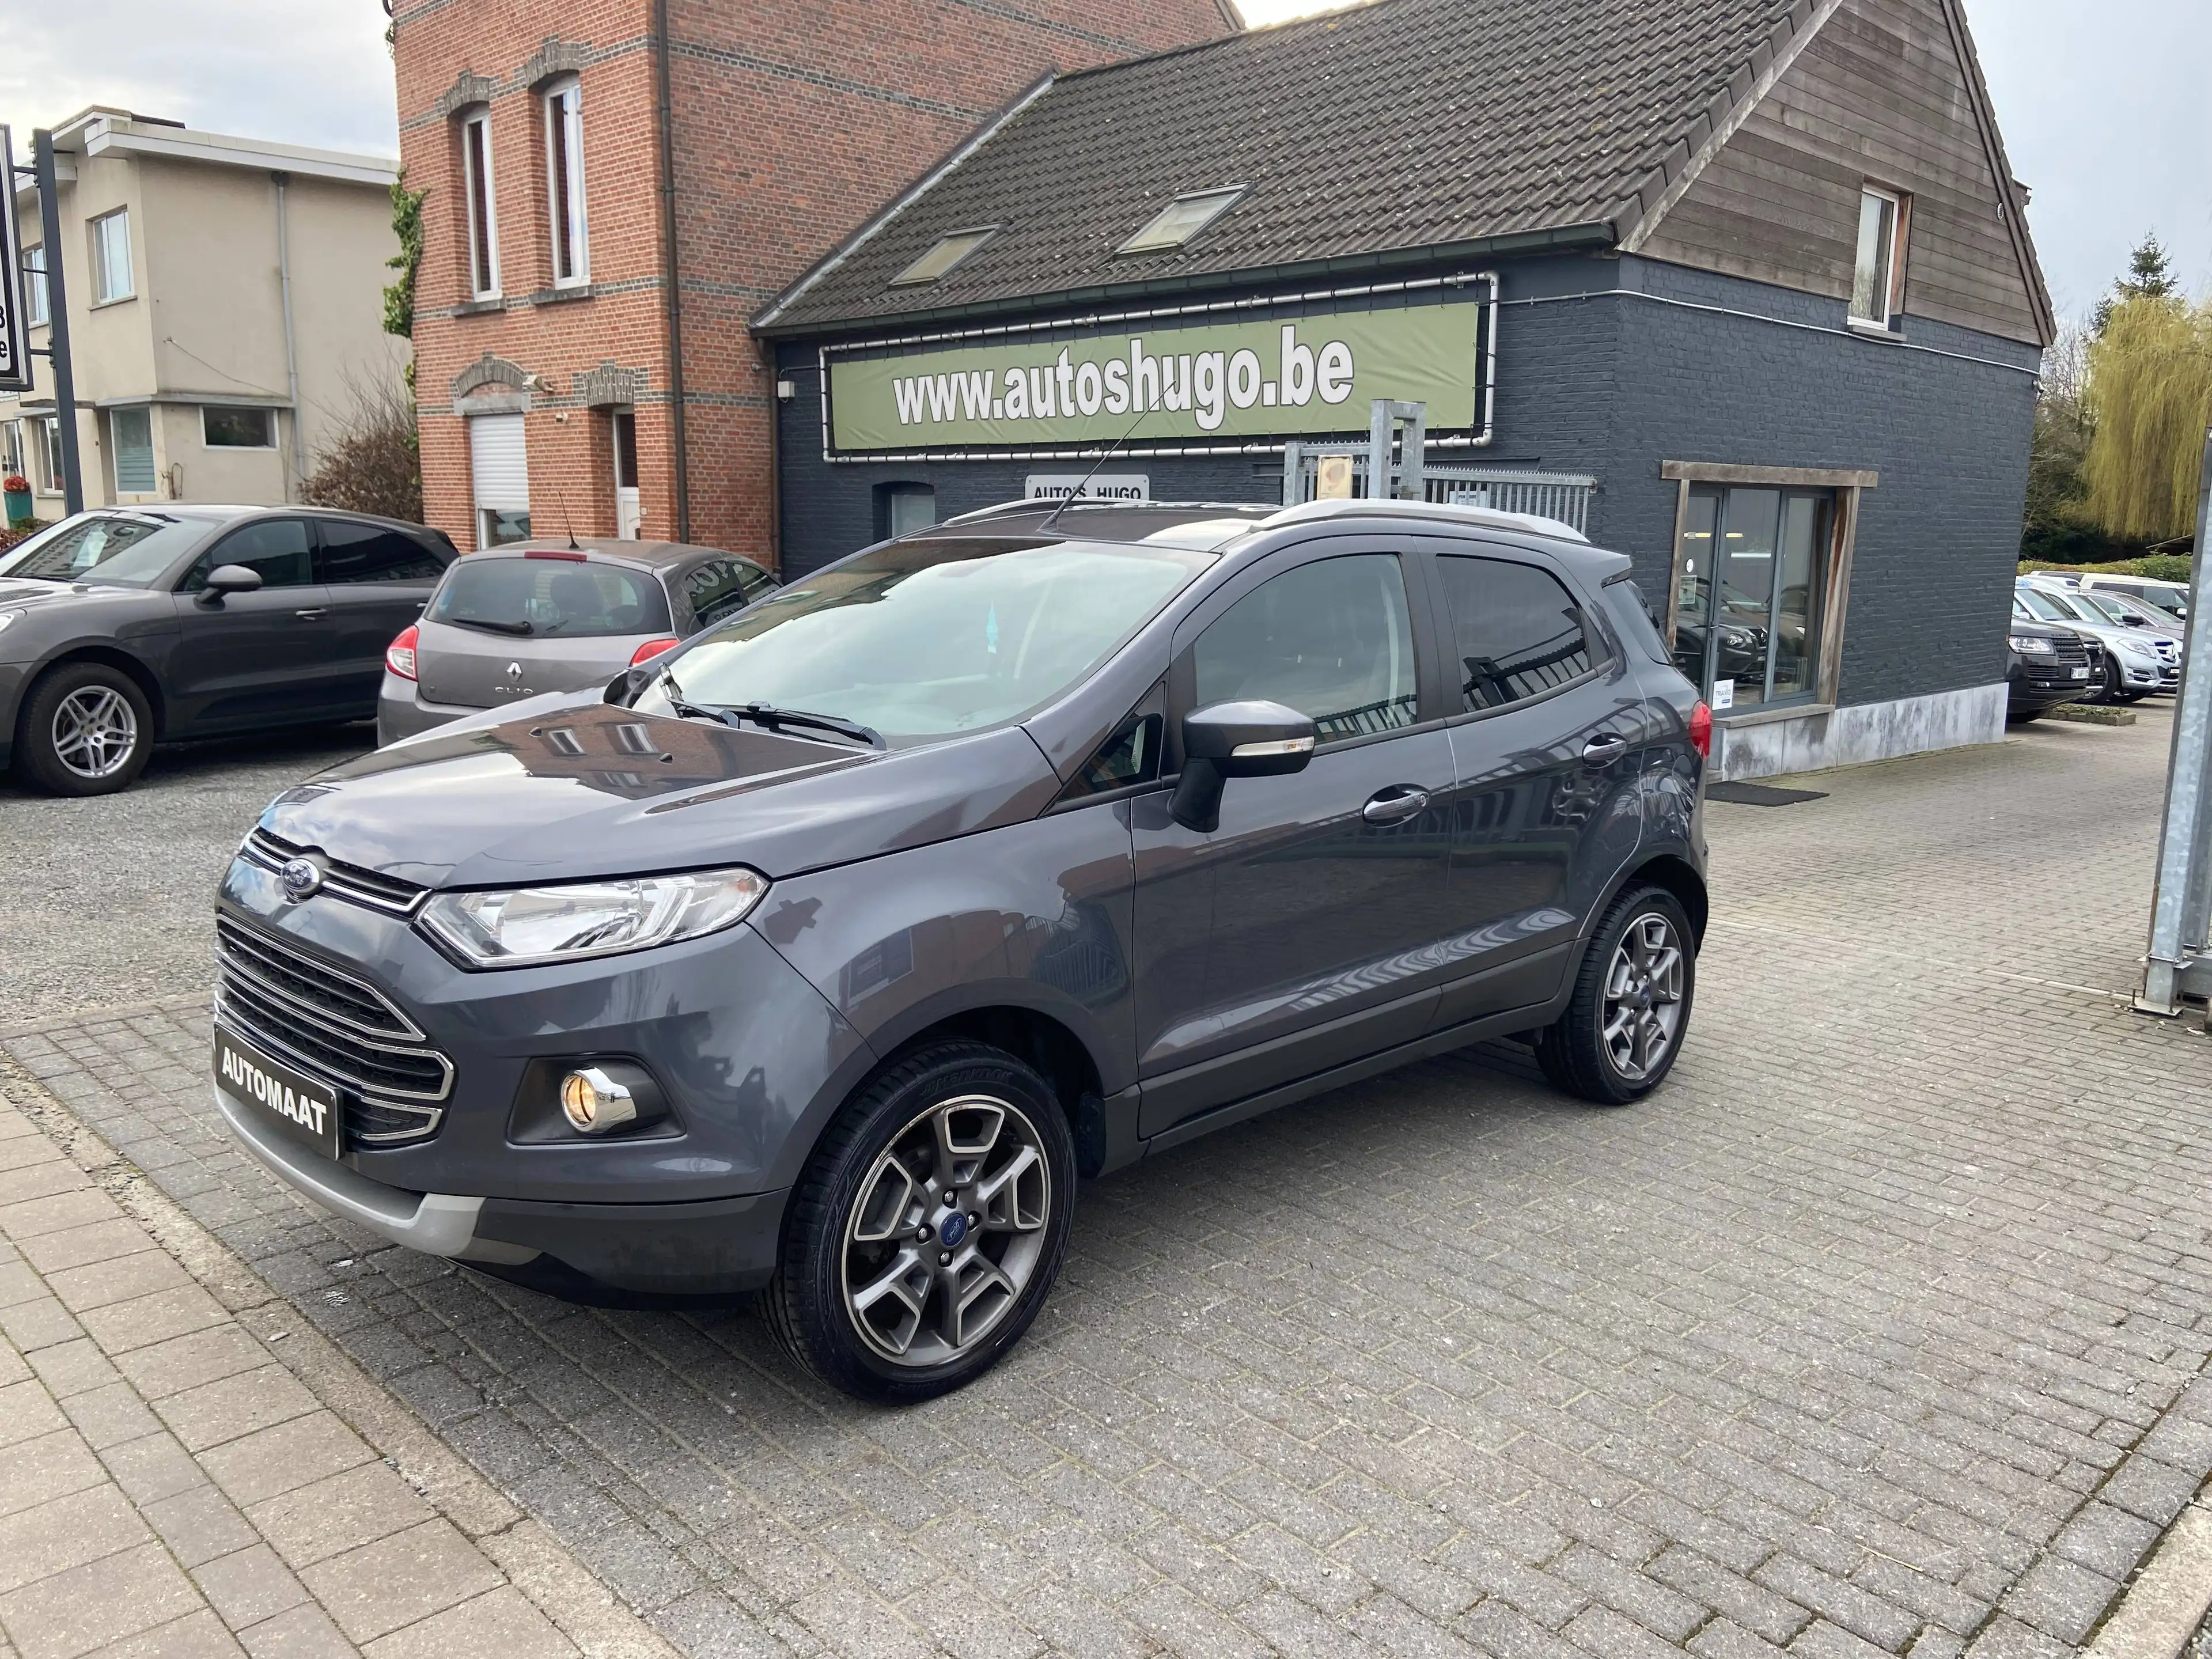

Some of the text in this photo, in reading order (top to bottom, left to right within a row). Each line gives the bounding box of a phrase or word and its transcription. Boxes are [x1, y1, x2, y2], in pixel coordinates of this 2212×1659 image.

[892, 324, 1354, 431] www.autoshugo.be
[1097, 487, 1141, 499] HUGO
[495, 687, 533, 695] CLIO
[222, 1046, 327, 1135] AUTOMAAT
